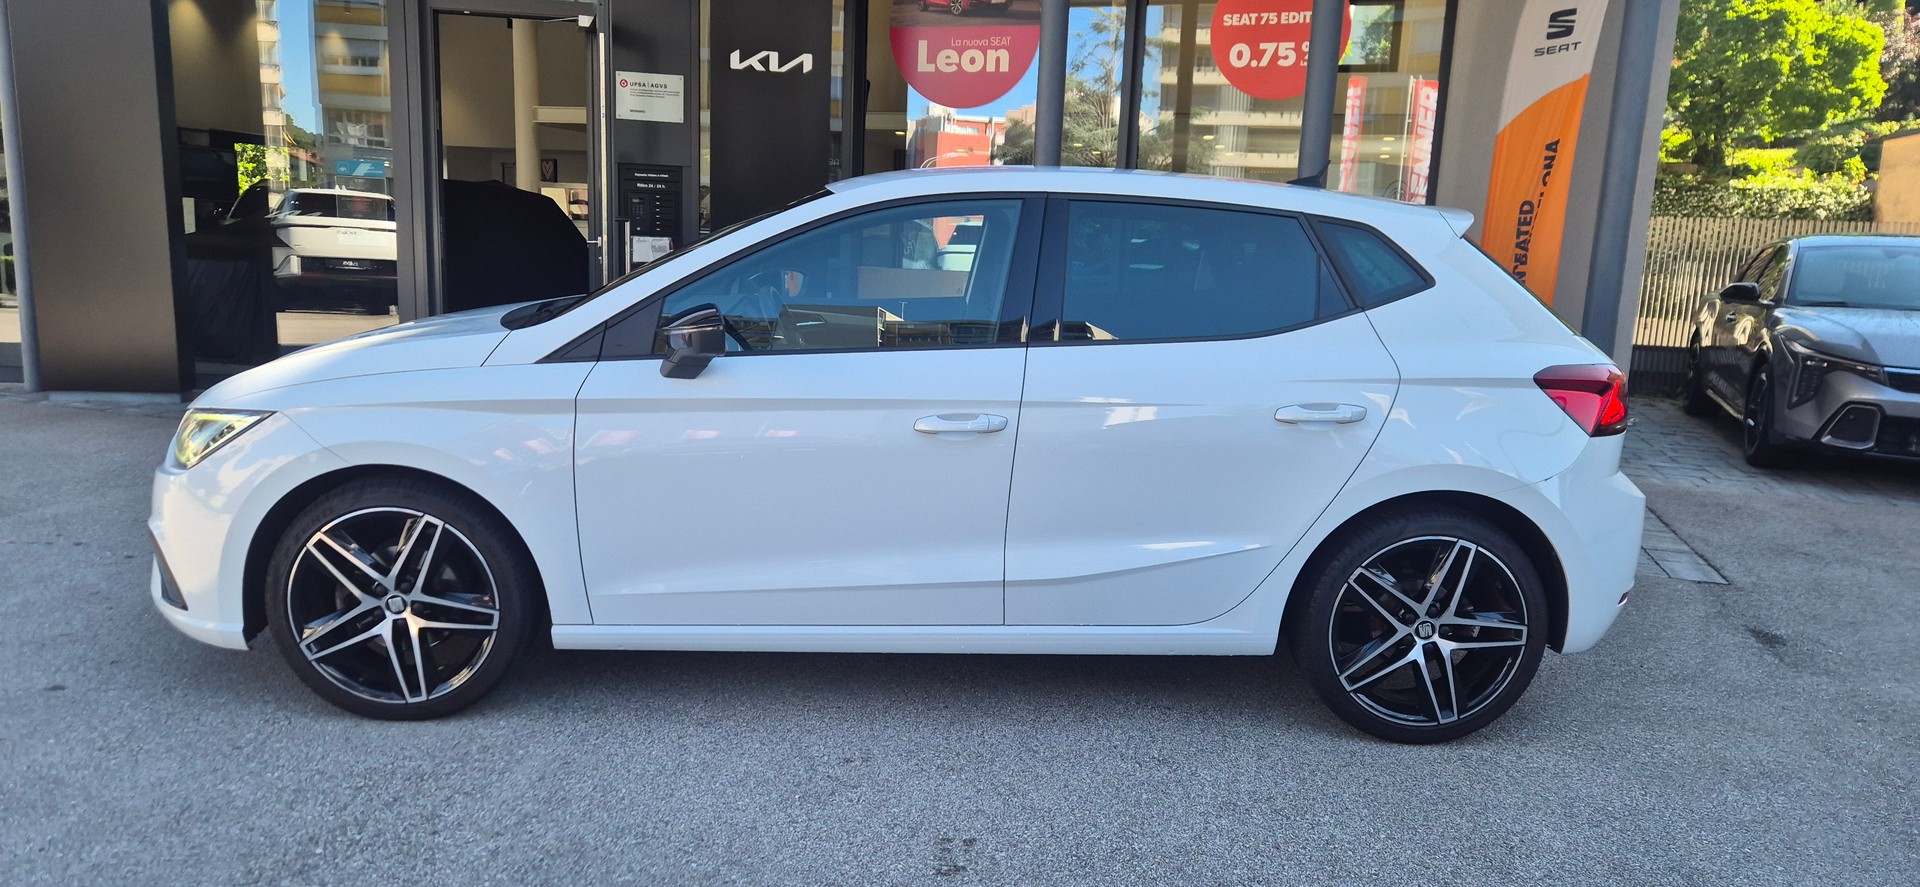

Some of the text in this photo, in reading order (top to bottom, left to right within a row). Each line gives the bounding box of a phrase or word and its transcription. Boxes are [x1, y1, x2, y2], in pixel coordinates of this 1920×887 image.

[1223, 13, 1258, 26] SEAT
[1260, 12, 1278, 25] 75
[951, 36, 1011, 47] La nuova SEAT
[1534, 41, 1581, 57] SEAT
[917, 39, 1010, 73] Leon
[1229, 41, 1297, 68] 0.75
